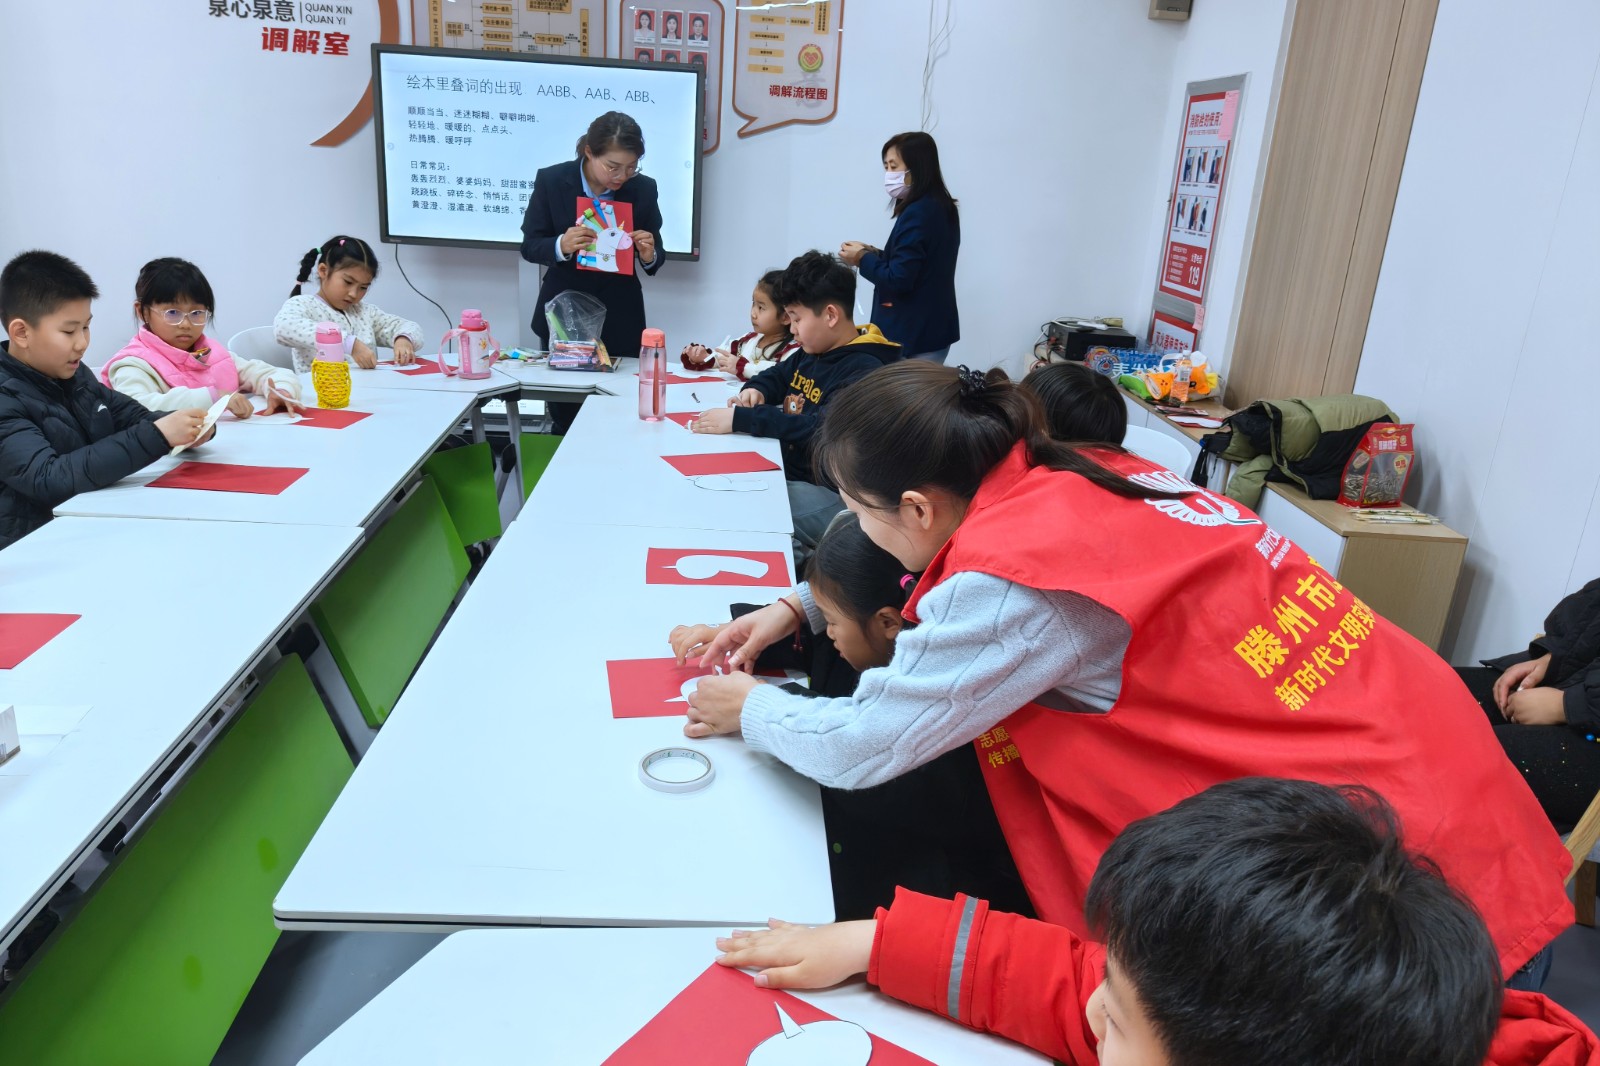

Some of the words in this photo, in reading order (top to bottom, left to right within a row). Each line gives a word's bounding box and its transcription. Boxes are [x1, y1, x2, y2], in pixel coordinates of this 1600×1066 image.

[208, 0, 295, 22] 泉心泉意
[305, 3, 333, 14] QUAN
[336, 5, 352, 15] XIN
[305, 14, 334, 24] QUAN
[337, 17, 346, 25] YI
[261, 26, 350, 56] 调解室
[406, 74, 522, 96] 绘本里叠词的出现
[769, 85, 828, 100] 调解流程图
[409, 133, 472, 146] 热腾腾、暖呼呼
[1188, 265, 1200, 285] 119
[977, 725, 1010, 749] 志愿
[988, 743, 1020, 768] 传播
